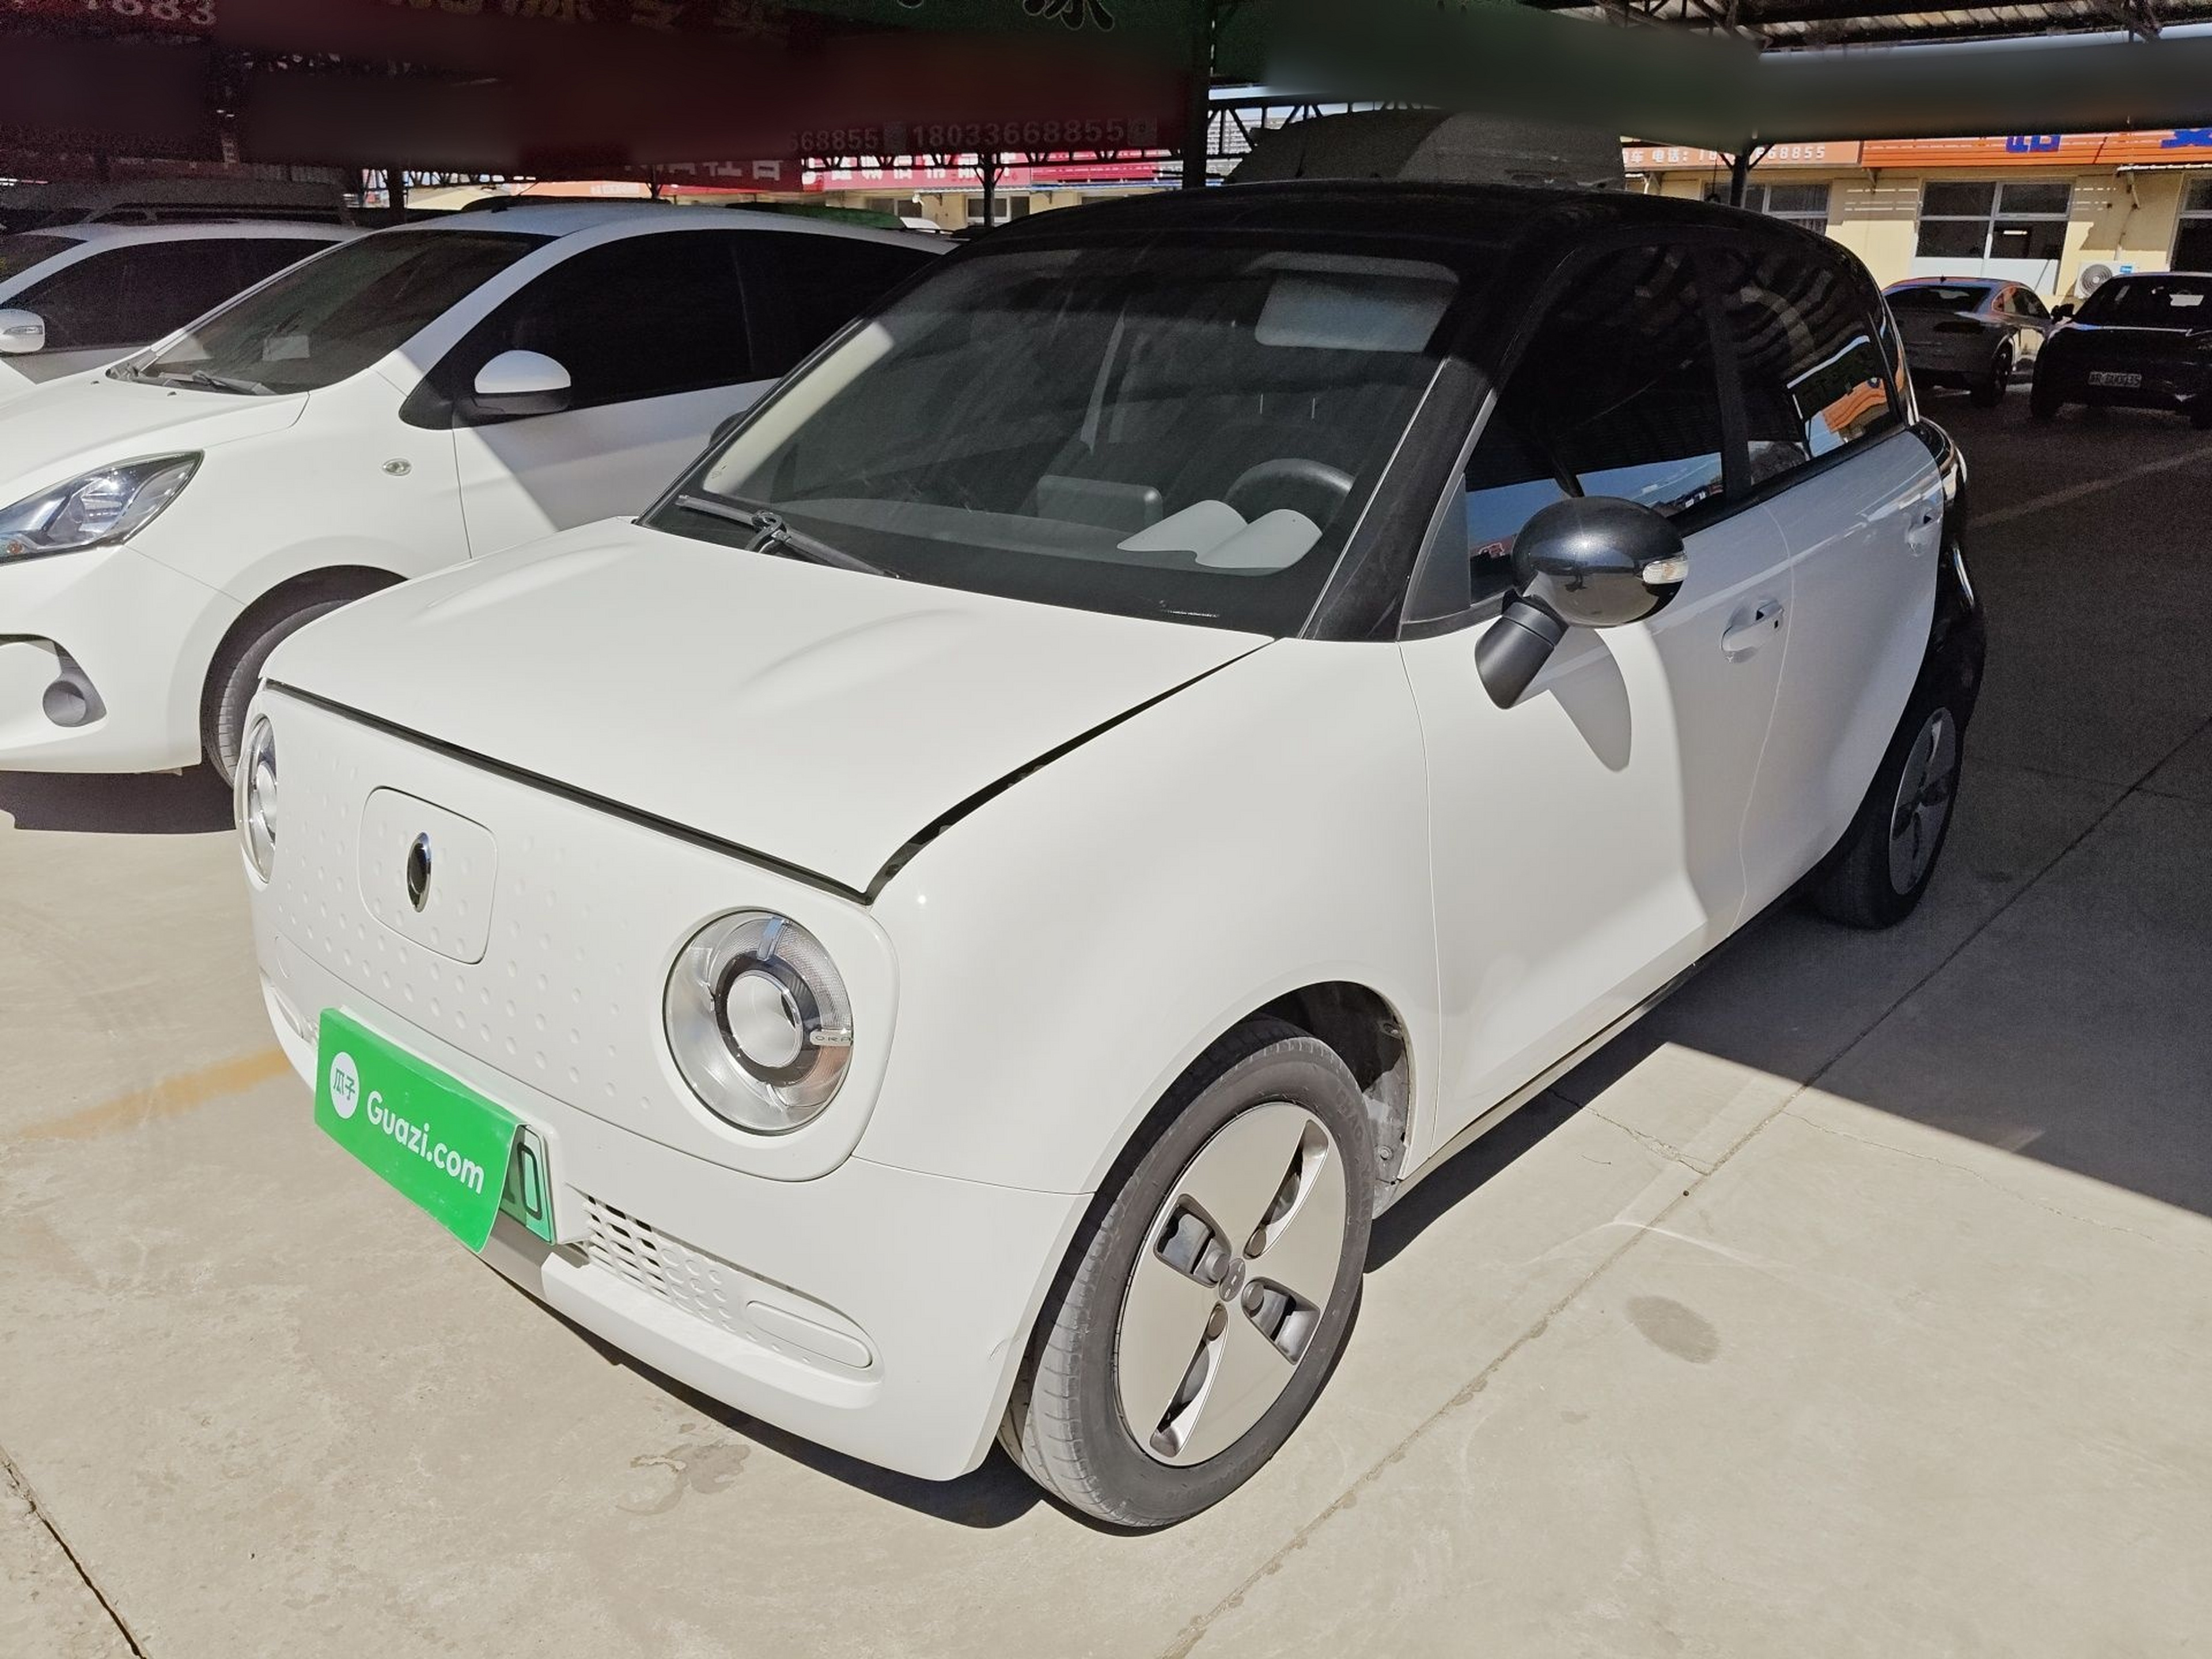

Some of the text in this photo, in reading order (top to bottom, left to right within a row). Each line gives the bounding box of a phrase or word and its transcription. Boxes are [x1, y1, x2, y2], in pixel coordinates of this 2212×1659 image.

[913, 118, 1124, 146] 18033668855
[333, 1067, 484, 1195] 瓜子 Guazi.com
